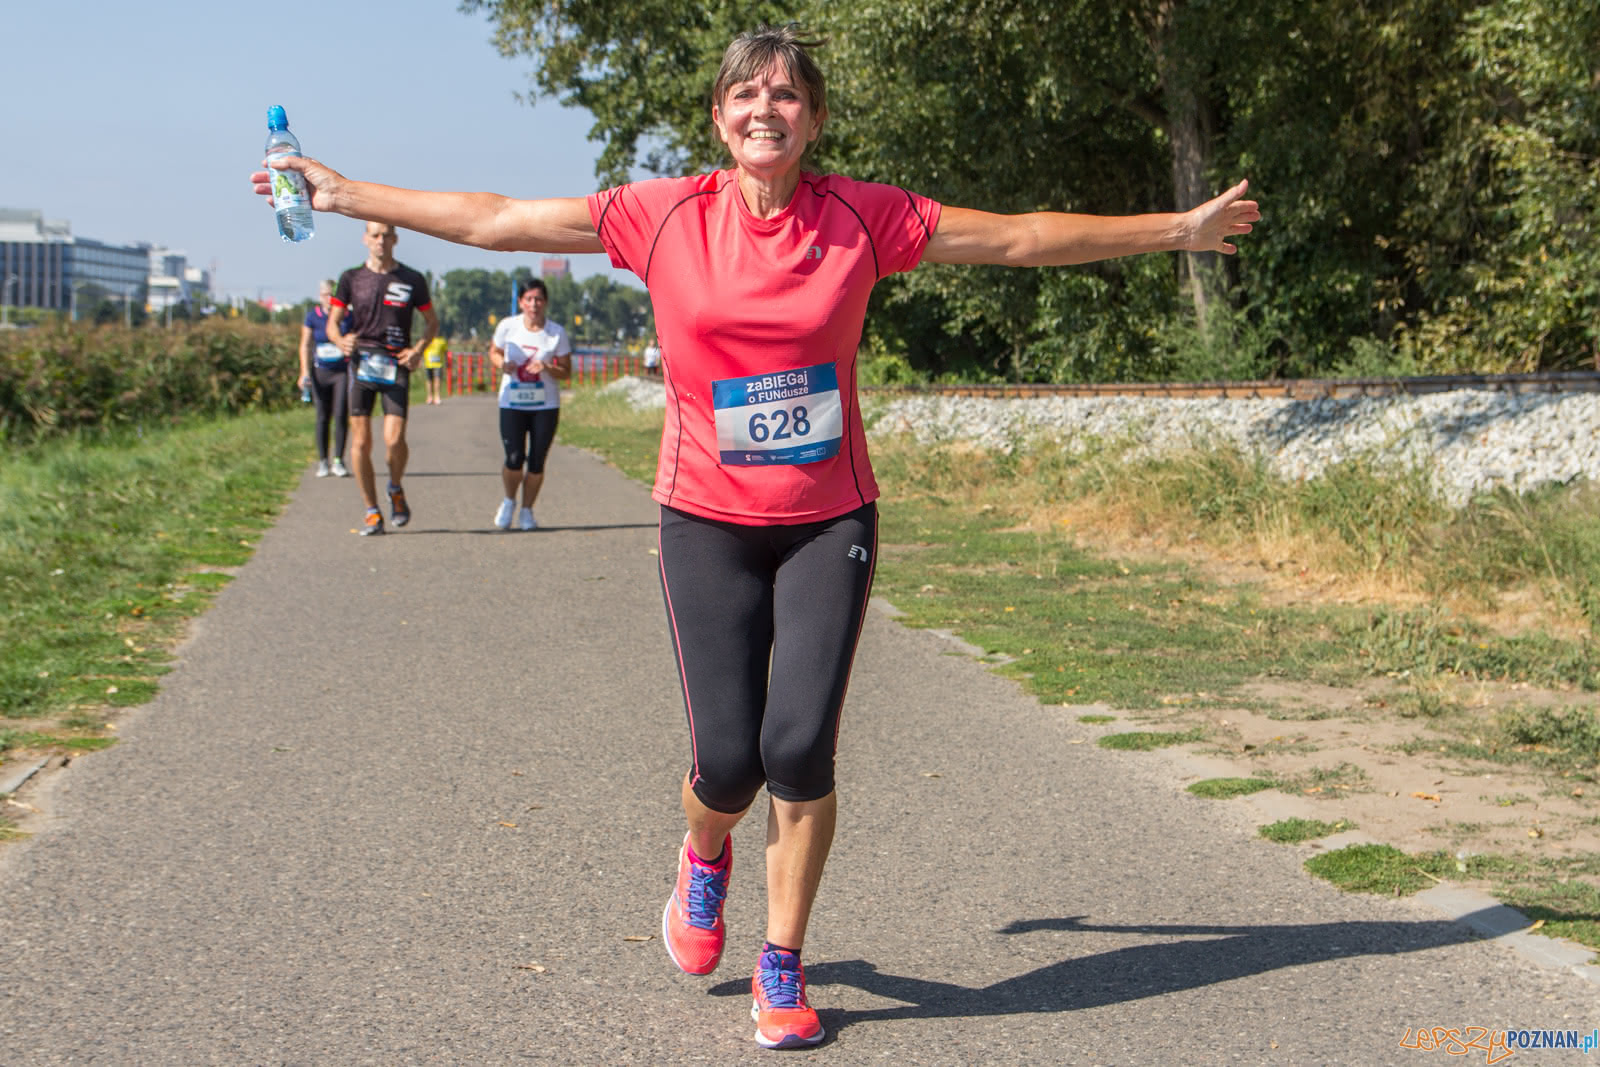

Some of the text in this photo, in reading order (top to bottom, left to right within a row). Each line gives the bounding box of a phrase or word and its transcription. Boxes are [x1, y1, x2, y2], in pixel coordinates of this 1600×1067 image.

[746, 371, 808, 393] zaBIEGaj
[748, 386, 809, 404] o FUNdusze
[748, 405, 811, 443] 628
